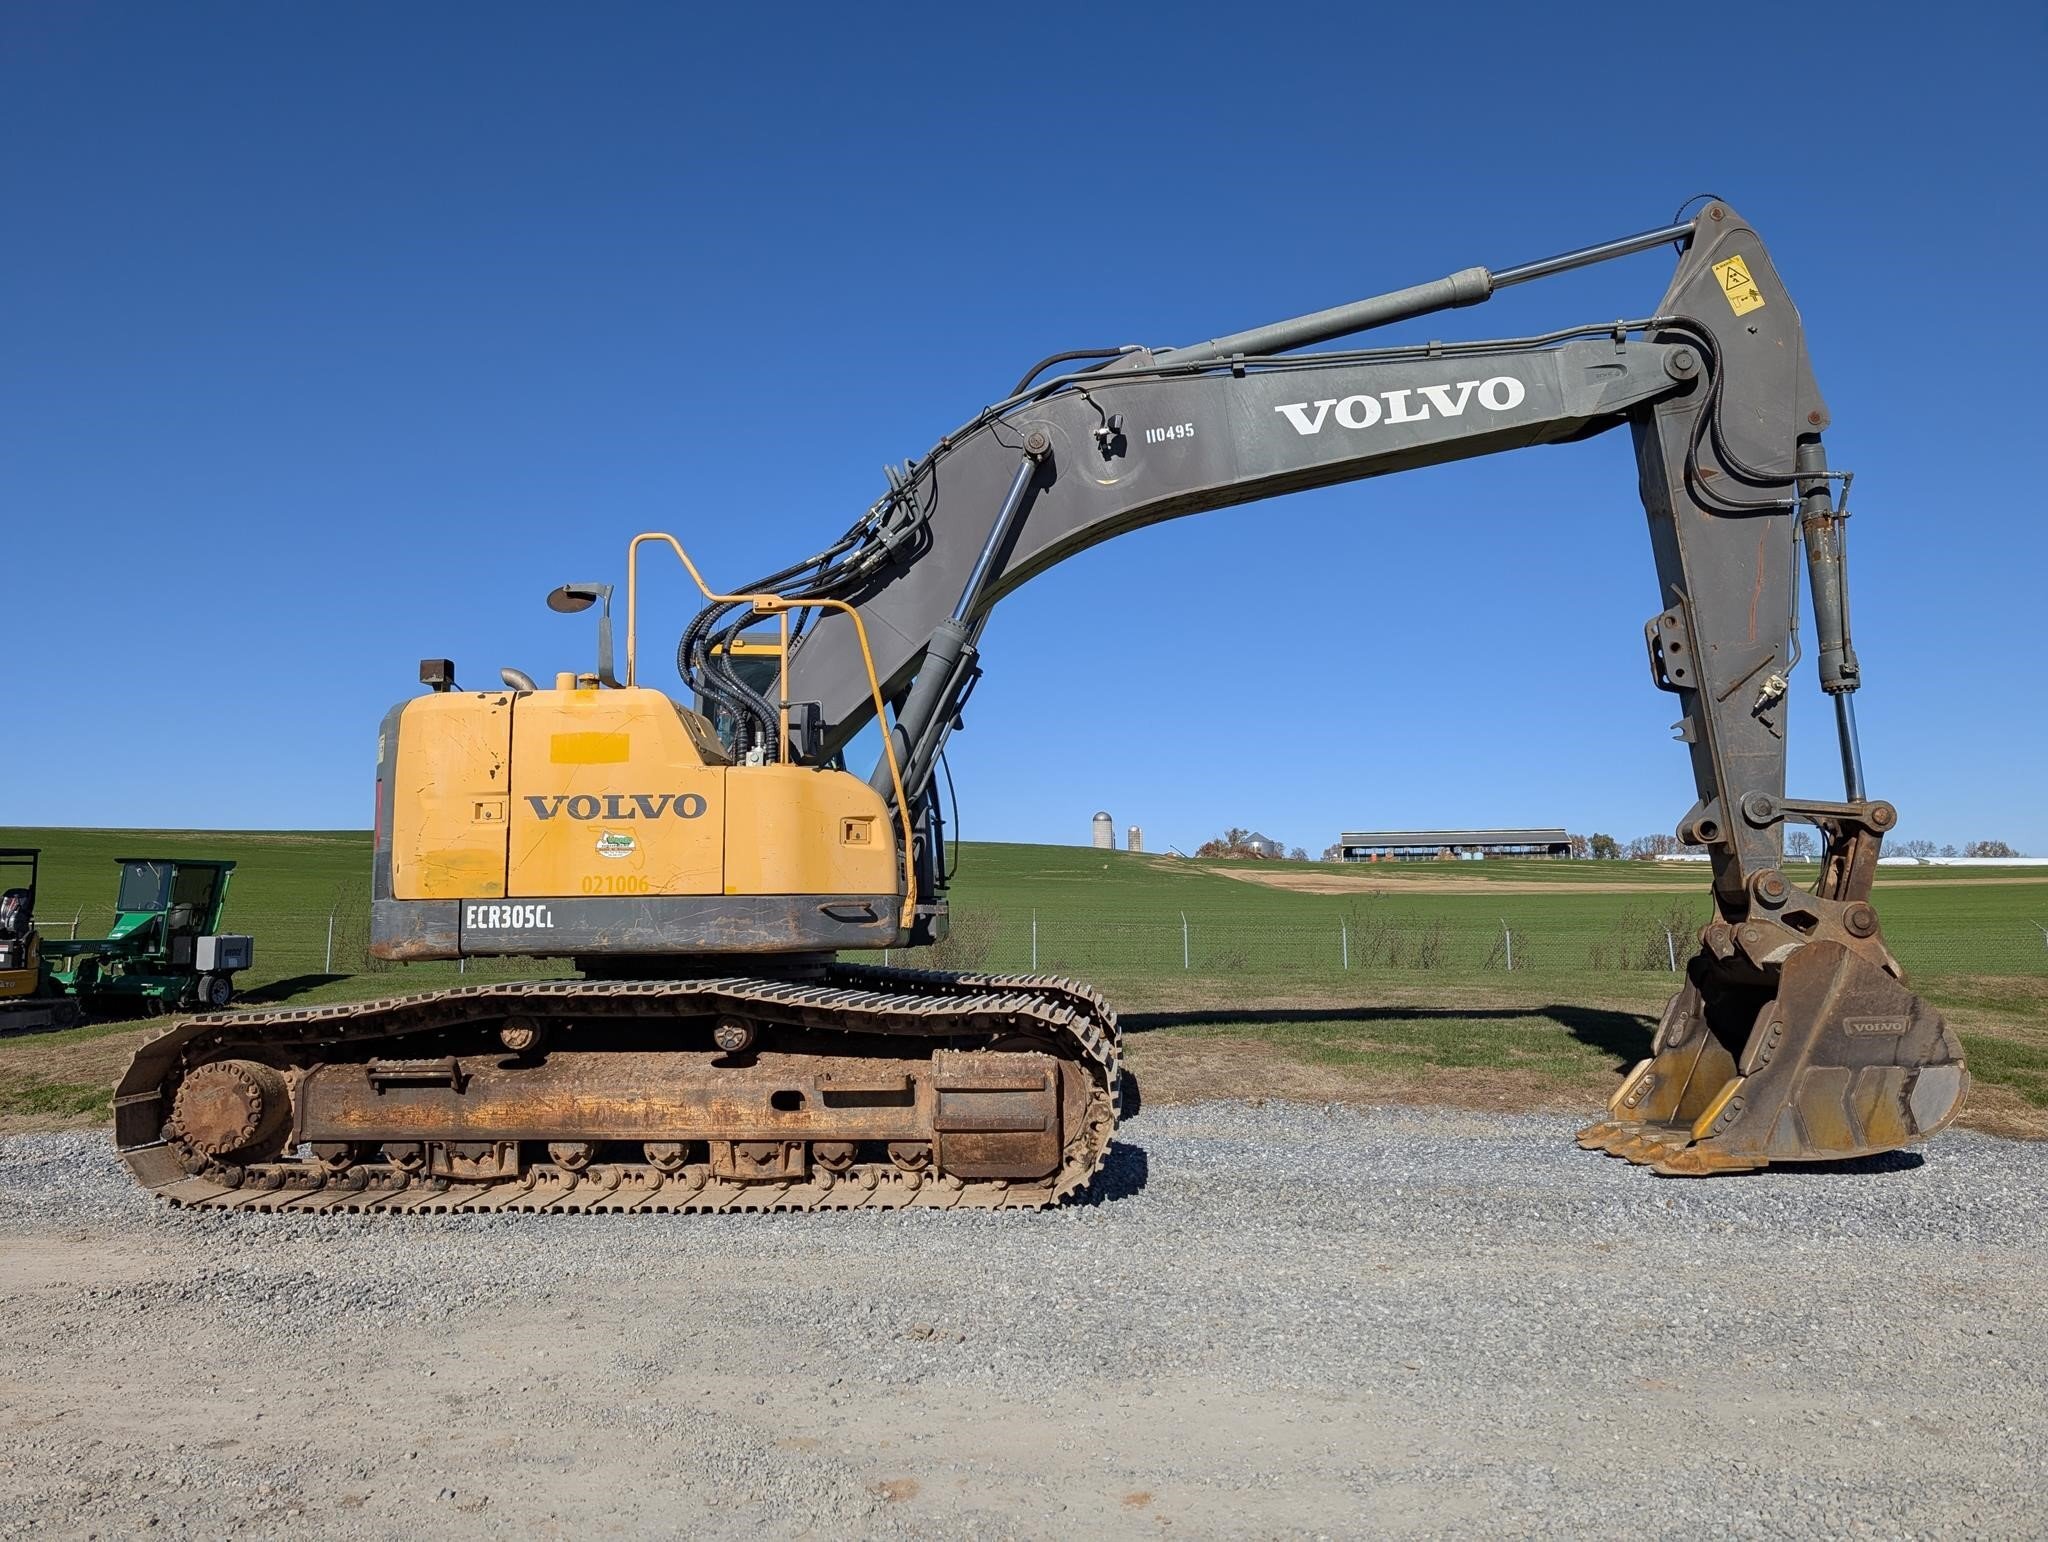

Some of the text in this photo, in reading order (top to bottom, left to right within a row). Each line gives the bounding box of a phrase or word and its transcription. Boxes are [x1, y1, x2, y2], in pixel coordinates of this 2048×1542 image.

[1274, 376, 1525, 435] VOLVO
[1146, 422, 1195, 444] 110495
[523, 793, 707, 820] VOLVO
[582, 875, 649, 894] 021006
[466, 904, 554, 929] ECR305CL
[1853, 1022, 1902, 1032] VOLVO
